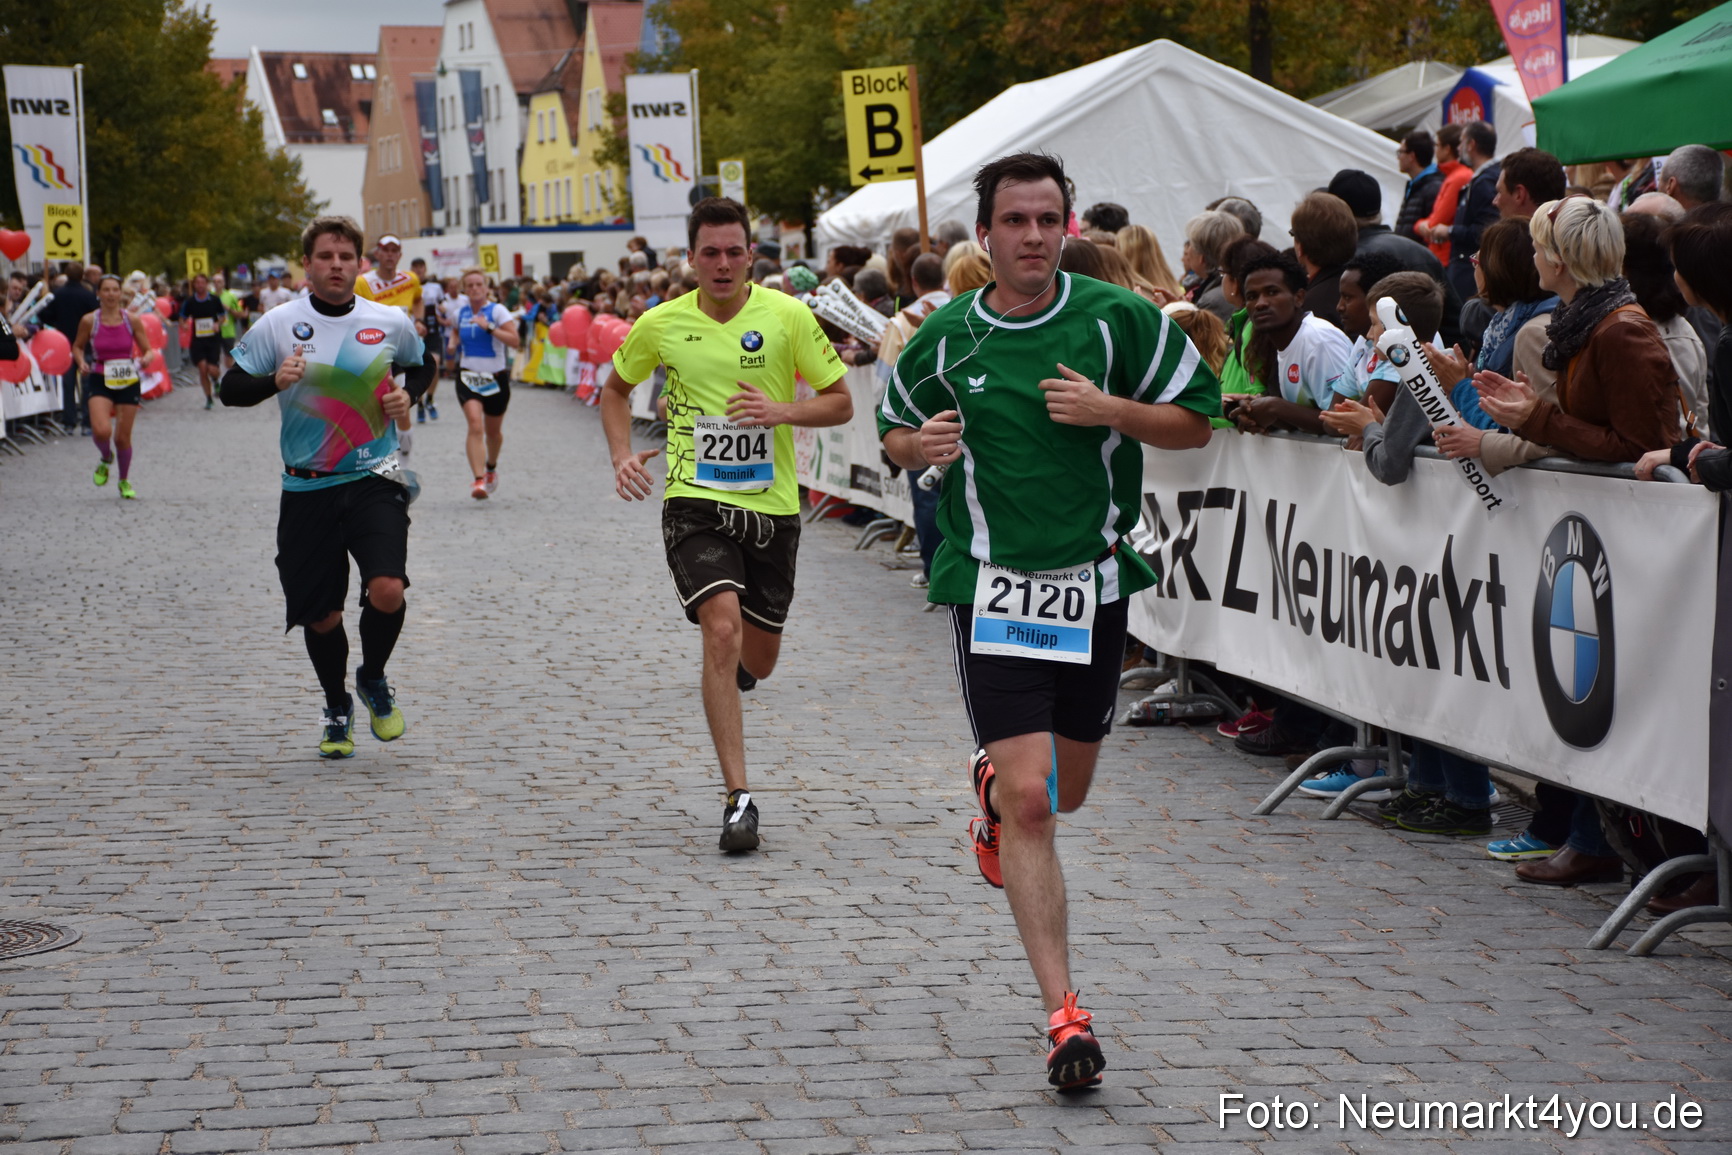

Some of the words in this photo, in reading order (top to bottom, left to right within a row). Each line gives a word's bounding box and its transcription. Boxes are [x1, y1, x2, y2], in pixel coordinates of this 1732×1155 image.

[852, 71, 909, 95] Block
[865, 103, 903, 158] B
[47, 205, 78, 217] Block
[53, 221, 73, 248] C
[192, 258, 203, 272] D
[484, 253, 495, 267] D
[740, 354, 765, 365] Partl
[1406, 374, 1450, 426] BMW
[696, 421, 721, 431] PARTL
[356, 447, 373, 459] 16.
[702, 433, 768, 462] 2204
[713, 467, 756, 480] Dominik
[1020, 567, 1074, 581] Neumarkt
[987, 576, 1086, 622] 2120
[1264, 498, 1511, 690] Neumarkt
[1006, 625, 1058, 649] Philipp
